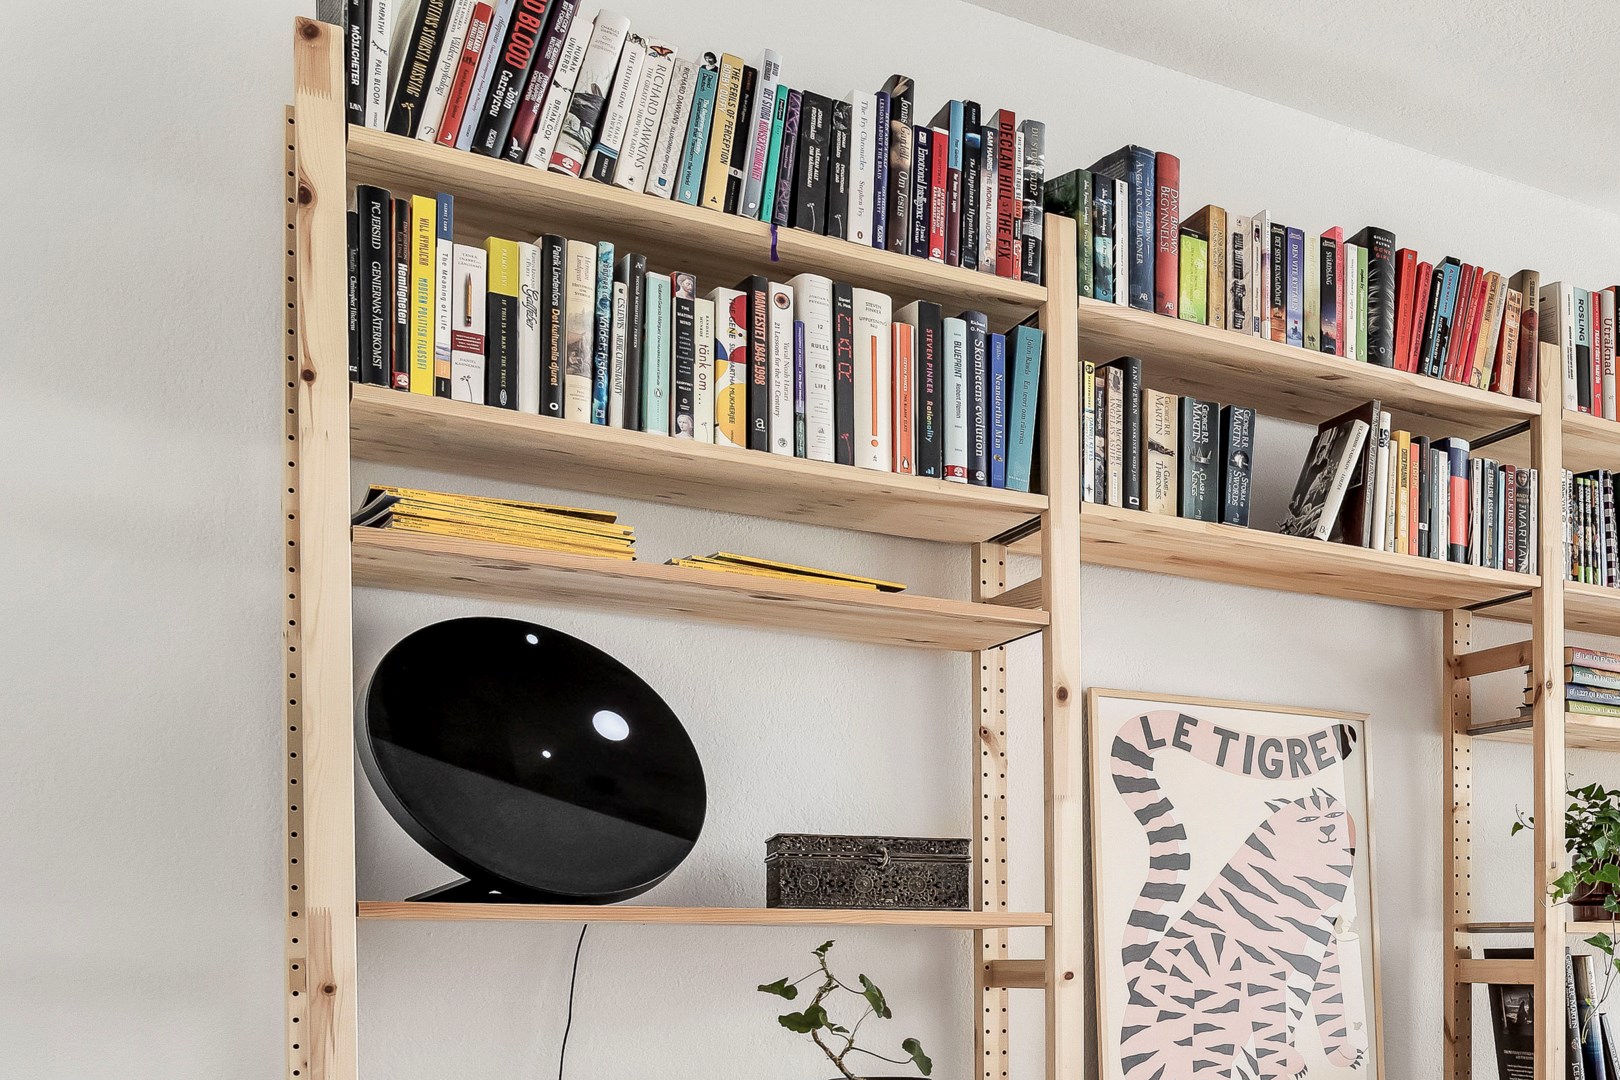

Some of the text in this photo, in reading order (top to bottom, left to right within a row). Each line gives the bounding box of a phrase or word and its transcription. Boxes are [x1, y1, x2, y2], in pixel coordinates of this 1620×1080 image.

[351, 25, 361, 85] MÖJLIGHETER
[407, 27, 437, 97] STÖRSTA MISSTAG
[505, 10, 531, 69] BLOOD
[560, 37, 576, 74] UNIVERSE
[569, 46, 582, 73] HUMAN
[373, 59, 382, 104] PAUL BLOOM
[490, 70, 512, 117] Carreyrou
[503, 87, 518, 109] John
[617, 51, 637, 109] THE SELFISH GENE
[543, 100, 561, 141] BRIAN COX
[627, 67, 653, 158] THE GREATEST SHOW ON EARTH
[634, 64, 667, 171] RICHARD DAWKINS
[661, 67, 690, 174] RICHARD DAWKINS ILLUSIONEN OM GUD
[719, 67, 741, 165] THE PERILS OF PERCEPTION
[860, 101, 869, 117] The
[860, 117, 868, 130] Fry
[859, 131, 867, 171] Chronicles
[896, 97, 911, 217] Jonas Gardell Om Jesus
[968, 169, 976, 206] Happiness
[998, 123, 1013, 260] DECLAN HILL THE FIX
[1136, 160, 1144, 196] ÄNGLAR
[967, 208, 975, 247] Hypothesis
[1160, 186, 1169, 253] BEGYNNELSE
[1170, 188, 1178, 256] DAN BROWN
[372, 201, 383, 369] PC JERSILD GENIERNAS ÅTERKOMST
[397, 263, 408, 324] Hemligheten
[440, 269, 448, 302] Meaning
[549, 245, 561, 386] Patrik Lindenfors Det kulturella djuret
[754, 291, 765, 385] MANIFESTET 1848-1998
[698, 344, 711, 368] tänk
[1604, 318, 1614, 375] Uträknad
[974, 339, 984, 456] Skönhetens evolution
[1156, 395, 1164, 435] MARTIN
[925, 401, 933, 442] Rationality
[1193, 402, 1201, 443] MARTIN
[1233, 408, 1243, 447] MARTIN
[1191, 470, 1199, 496] KINGS
[1232, 470, 1241, 506] SWORDS
[1140, 714, 1336, 778] LE TIGRE
[1572, 1062, 1580, 1076] ICE
